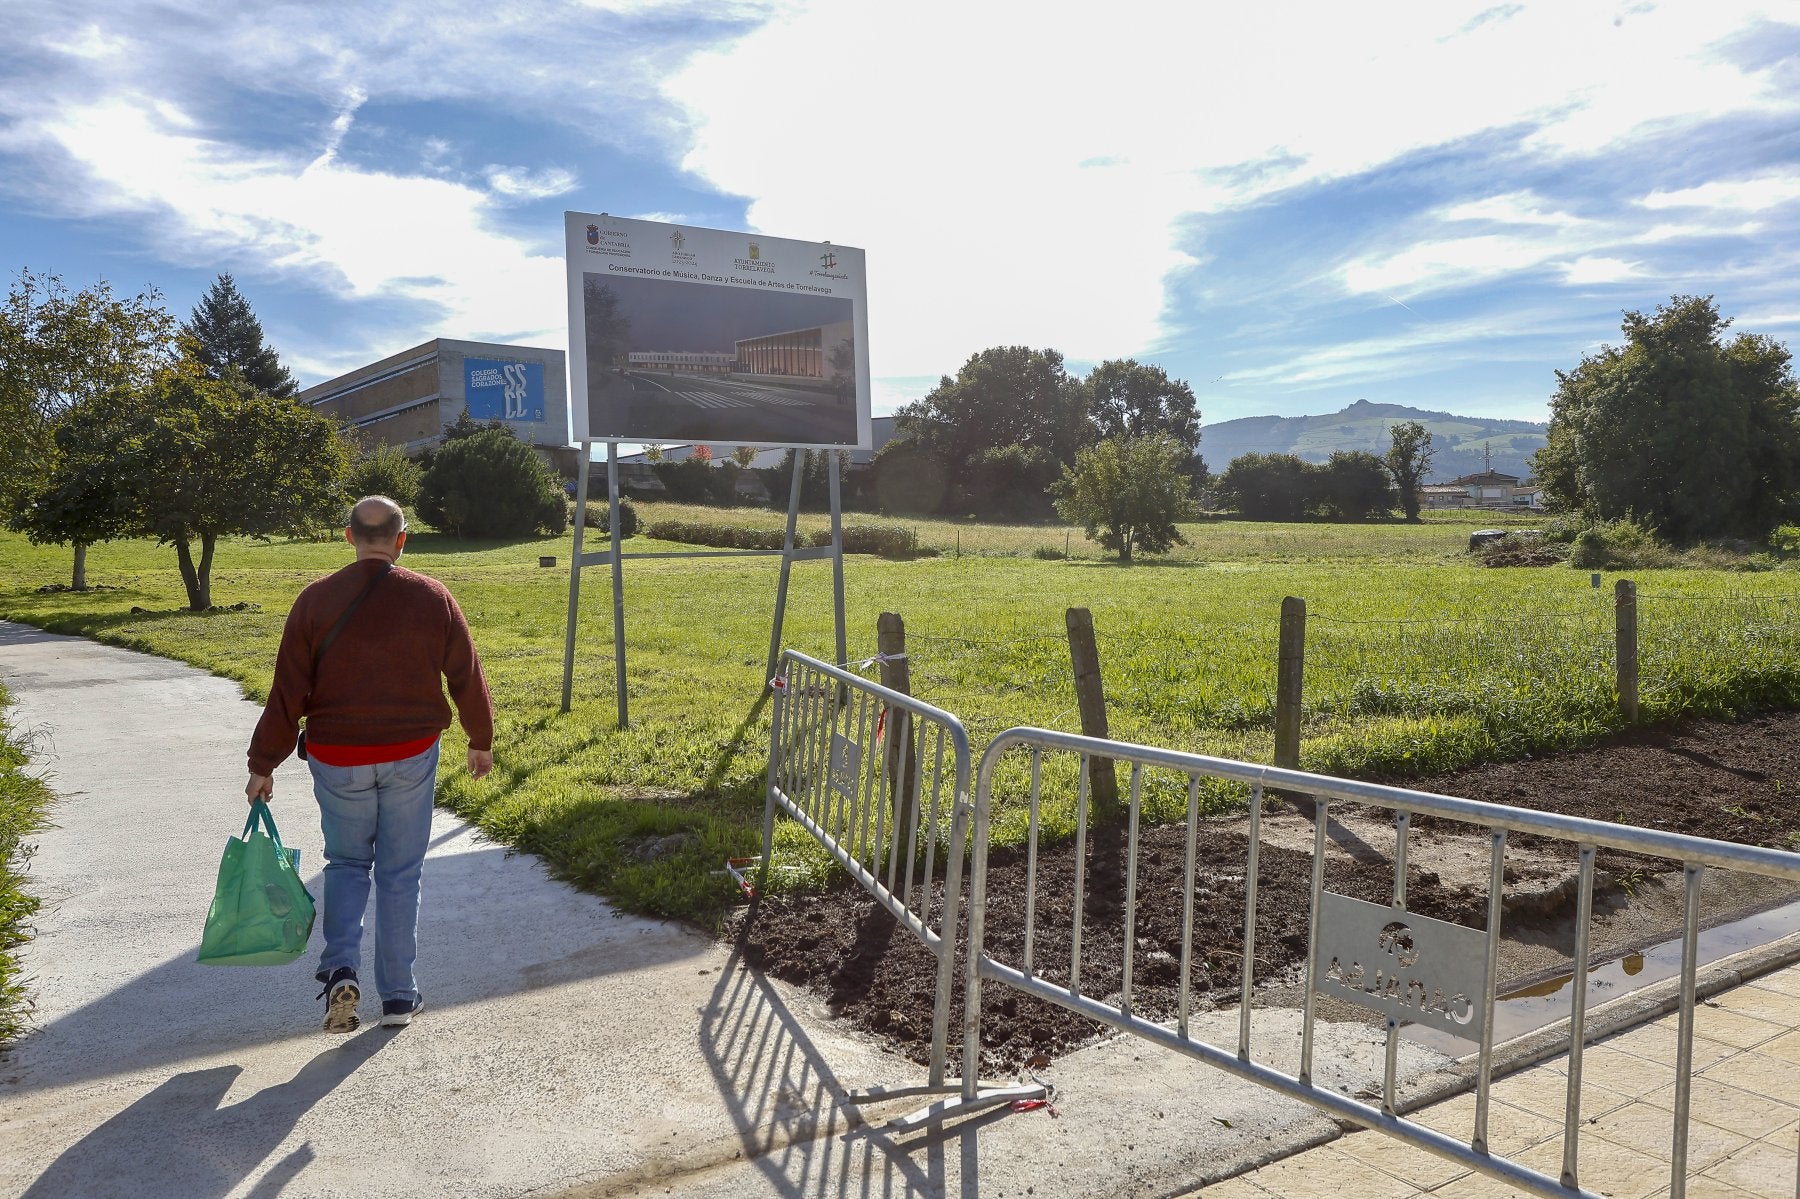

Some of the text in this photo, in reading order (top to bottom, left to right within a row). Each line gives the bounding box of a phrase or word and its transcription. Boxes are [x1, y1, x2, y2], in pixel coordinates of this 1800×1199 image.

[734, 259, 776, 267] AYUNTAMIENTO
[734, 264, 775, 273] TORRELAVEGA
[608, 263, 832, 295] Conservatorio de Música, Danza y Escuela de Artes de Torrelavega
[471, 368, 498, 376] COLEGIO
